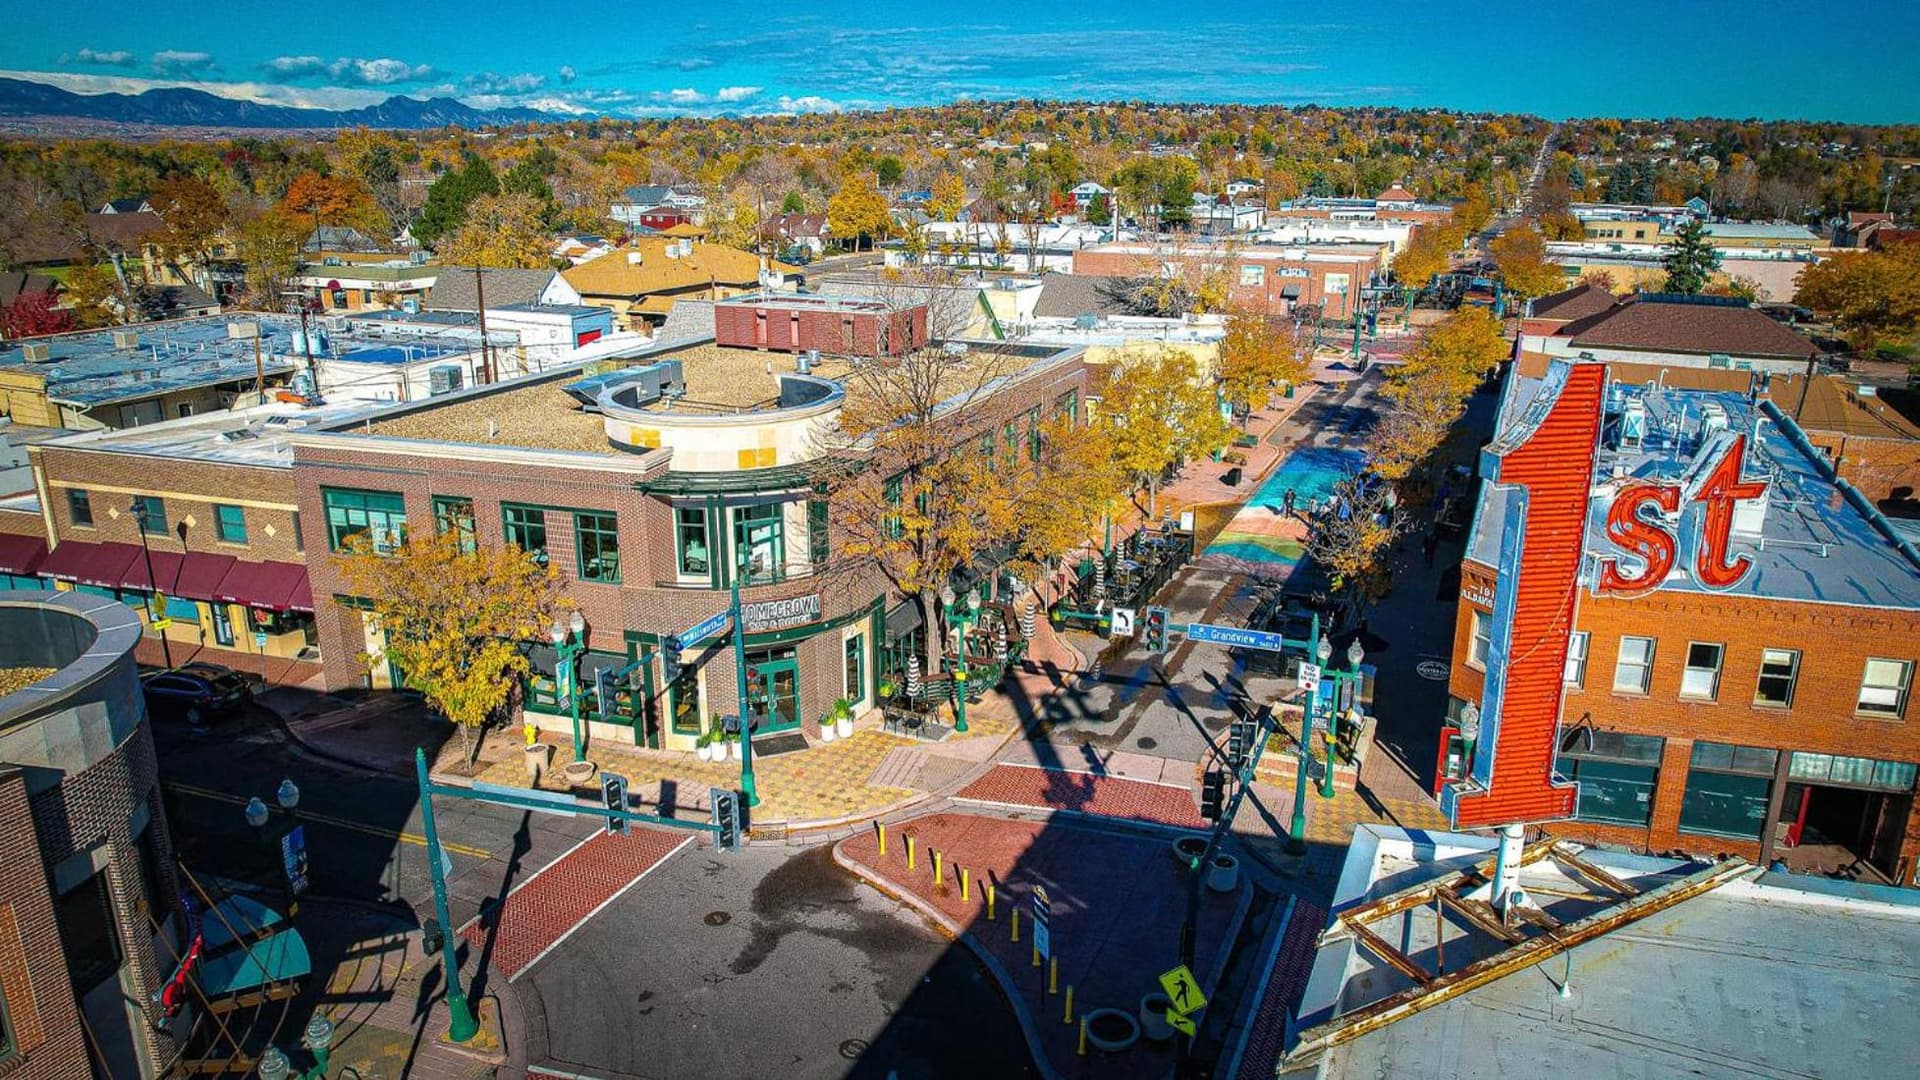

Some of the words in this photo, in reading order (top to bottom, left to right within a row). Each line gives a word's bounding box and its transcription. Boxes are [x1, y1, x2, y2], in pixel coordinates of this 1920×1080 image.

[740, 594, 820, 623] HOMEGROWN
[1211, 629, 1256, 644] Grandview
[1305, 664, 1316, 672] NO
